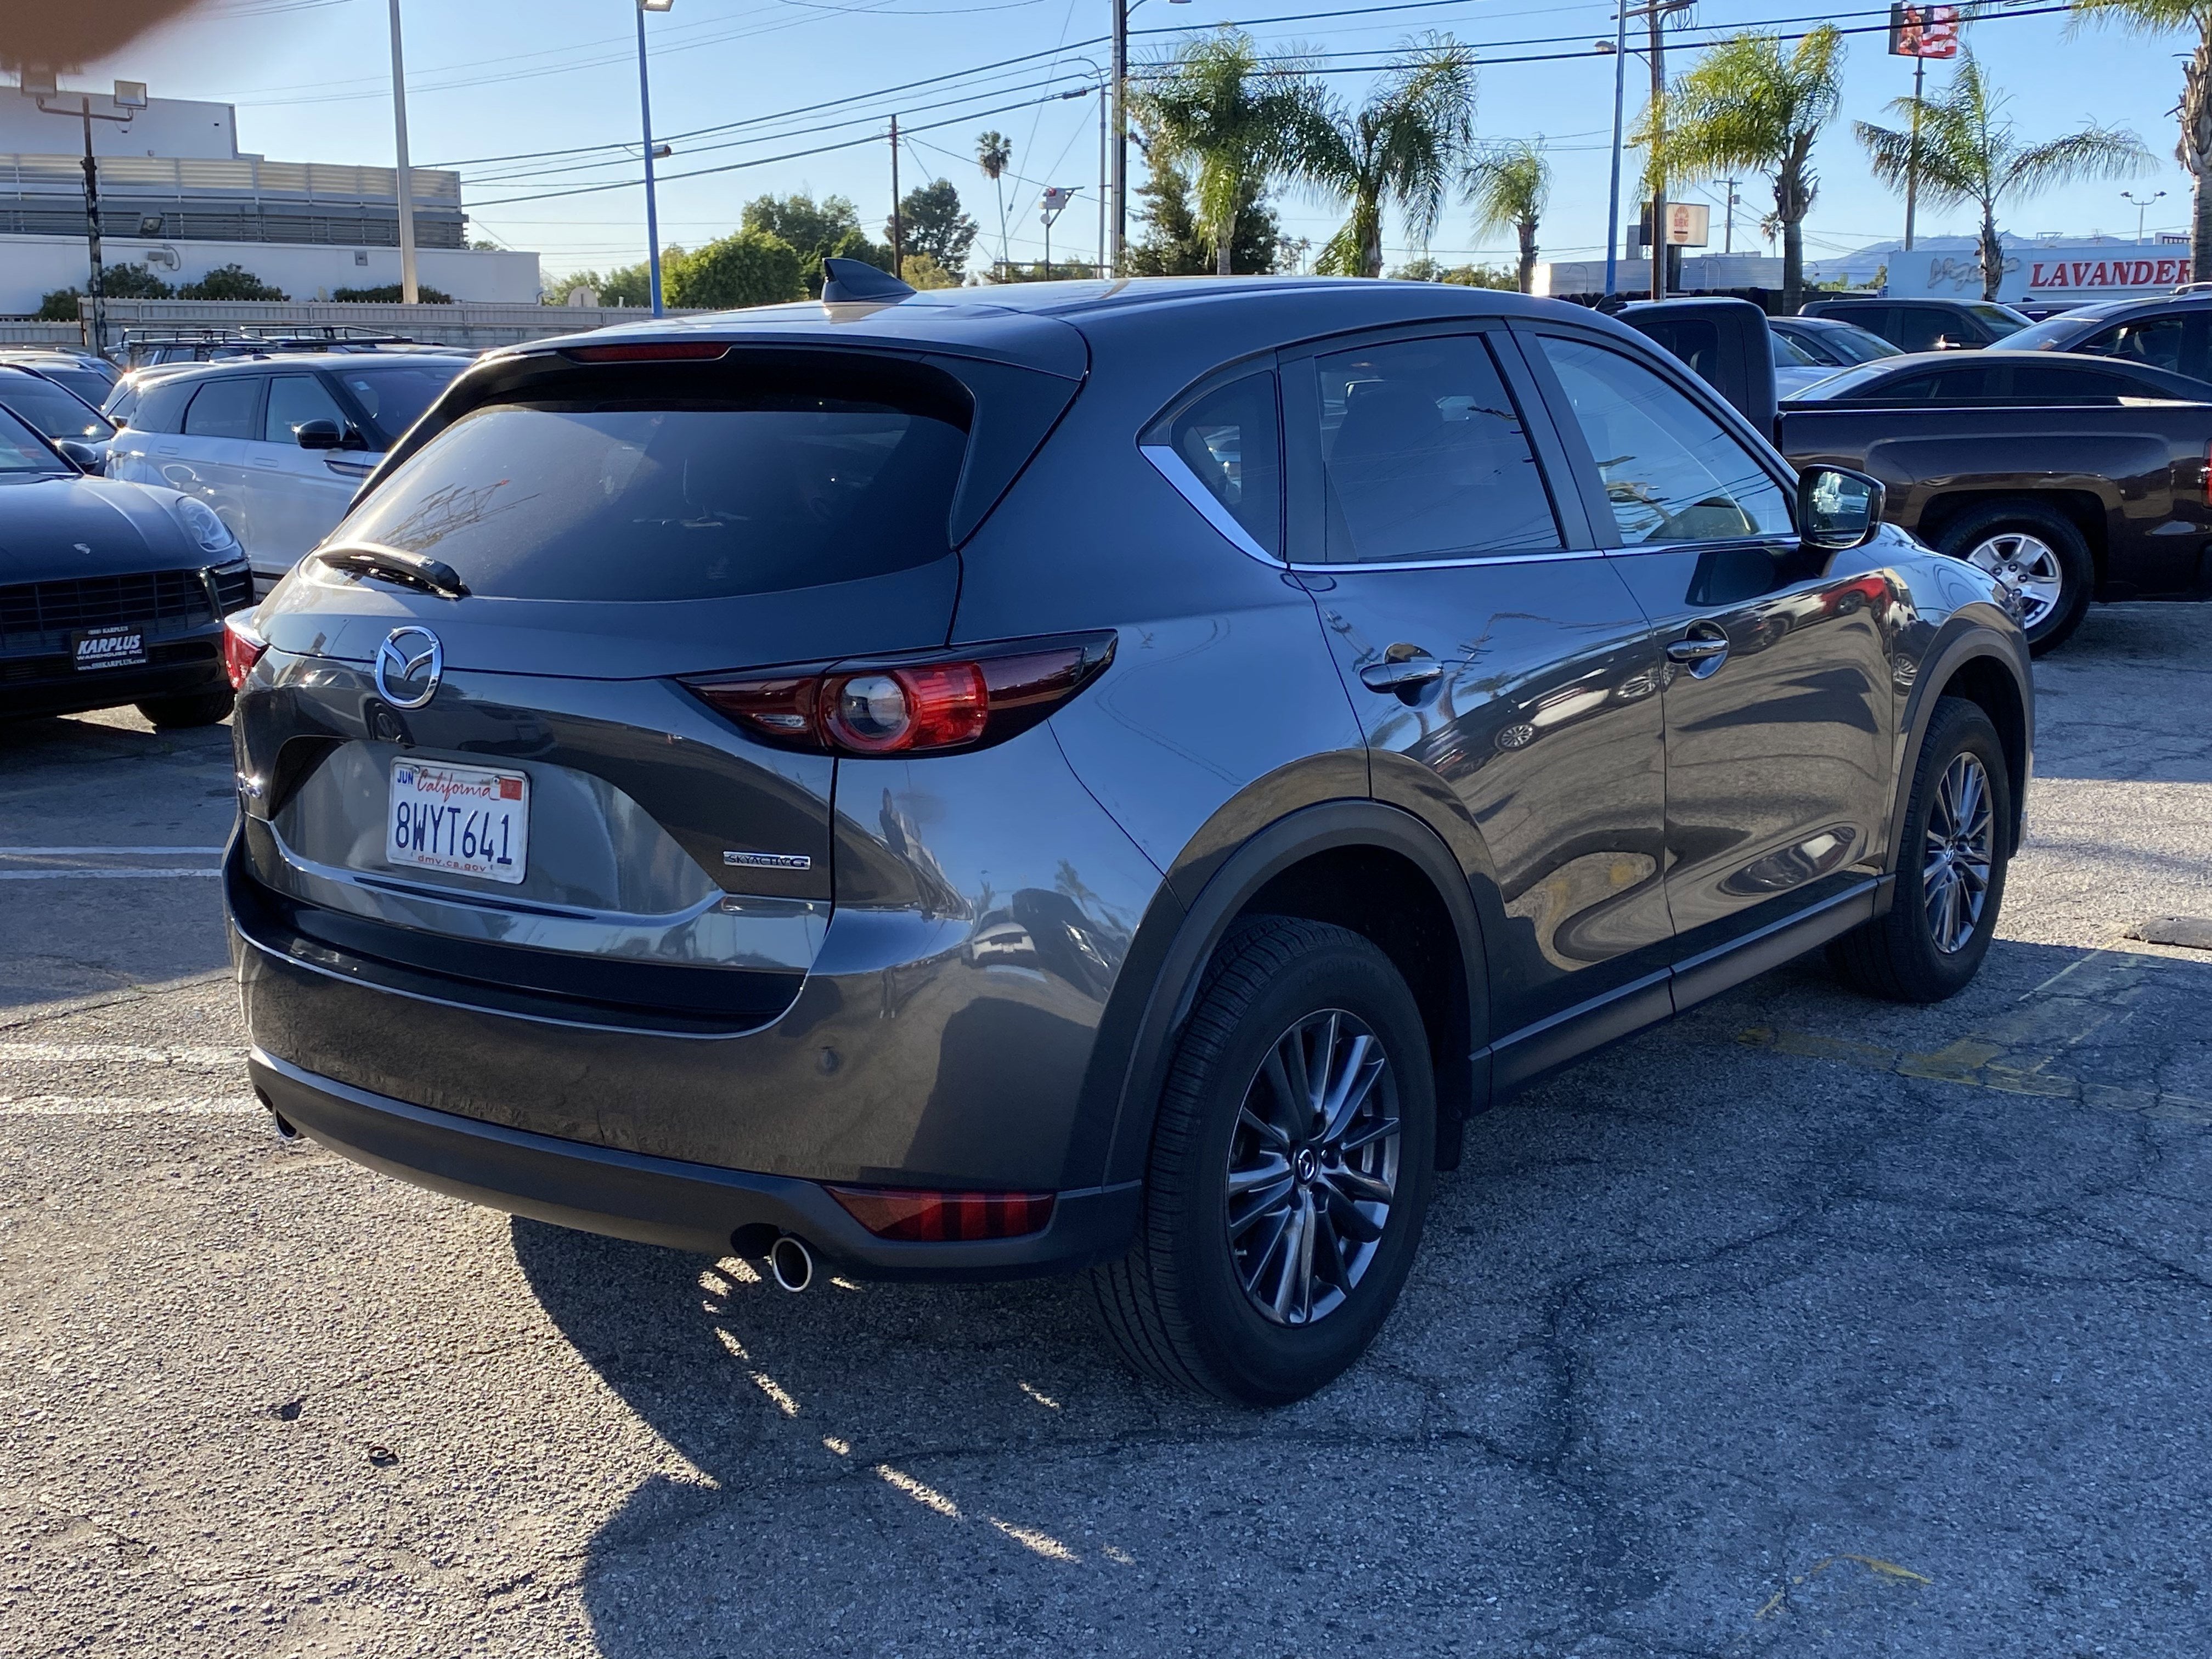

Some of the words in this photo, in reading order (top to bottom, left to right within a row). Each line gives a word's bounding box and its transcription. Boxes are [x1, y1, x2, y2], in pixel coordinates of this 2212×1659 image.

[77, 635, 141, 655] KARPLUS
[76, 651, 127, 661] WAREHOUSE
[397, 769, 414, 785] JUN
[417, 769, 500, 803] California
[396, 802, 512, 865] 8WYT641
[418, 855, 486, 872] dmv.ca.gov
